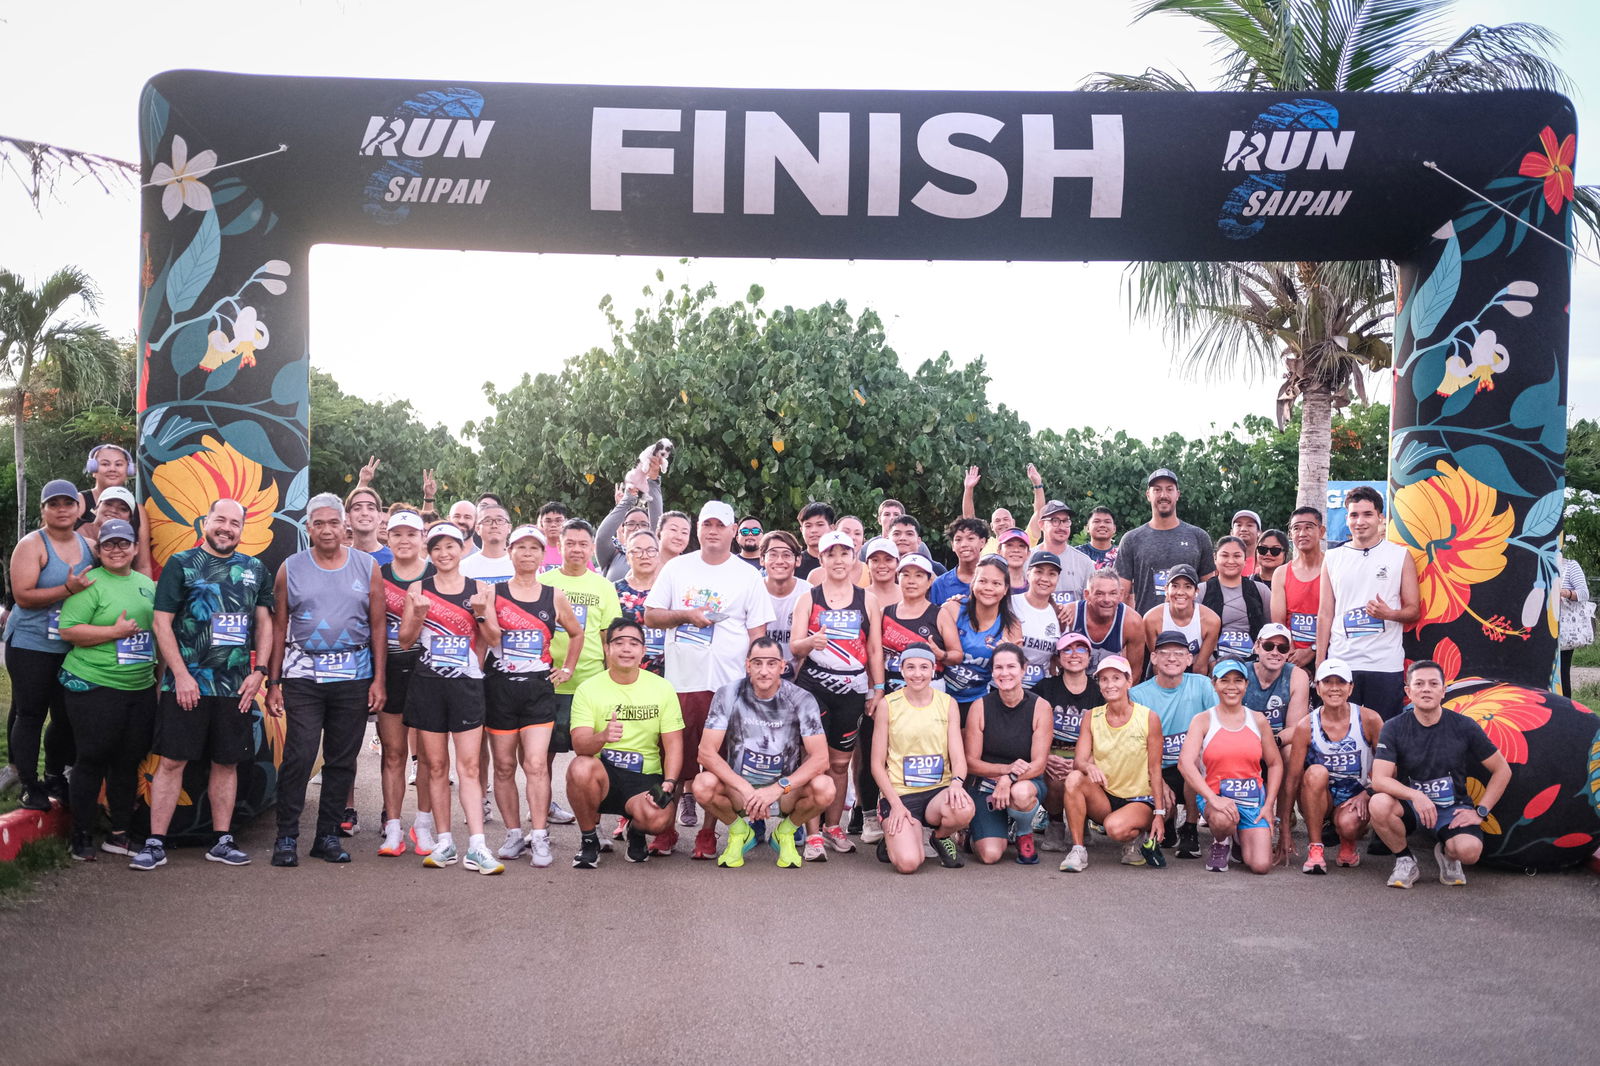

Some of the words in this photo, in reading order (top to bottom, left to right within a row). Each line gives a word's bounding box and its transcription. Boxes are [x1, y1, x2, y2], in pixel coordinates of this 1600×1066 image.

[359, 115, 496, 159] RUN
[1221, 130, 1356, 171] RUN
[590, 106, 1125, 220] FINISH
[384, 176, 491, 204] SAIPAN
[1242, 190, 1353, 216] SAIPAN
[567, 595, 600, 607] INISHER
[1051, 592, 1071, 602] 360
[218, 614, 248, 627] 2316
[824, 611, 857, 622] 2353
[1348, 608, 1369, 621] 237
[122, 632, 150, 646] 2327
[507, 631, 539, 643] 2355
[772, 629, 791, 643] SAIP
[1223, 631, 1250, 642] 2339
[436, 637, 467, 649] 2356
[319, 652, 352, 665] 2317
[951, 665, 981, 681] 2324
[1026, 665, 1041, 676] 09
[622, 709, 660, 719] FINISHER
[1265, 709, 1280, 719] 20
[1163, 733, 1187, 748] 348
[607, 750, 640, 765] 2343
[748, 752, 781, 765] 2319
[908, 756, 941, 769] 2307
[1323, 754, 1357, 766] 2333
[1226, 780, 1257, 791] 2349
[1414, 780, 1450, 793] 2362
